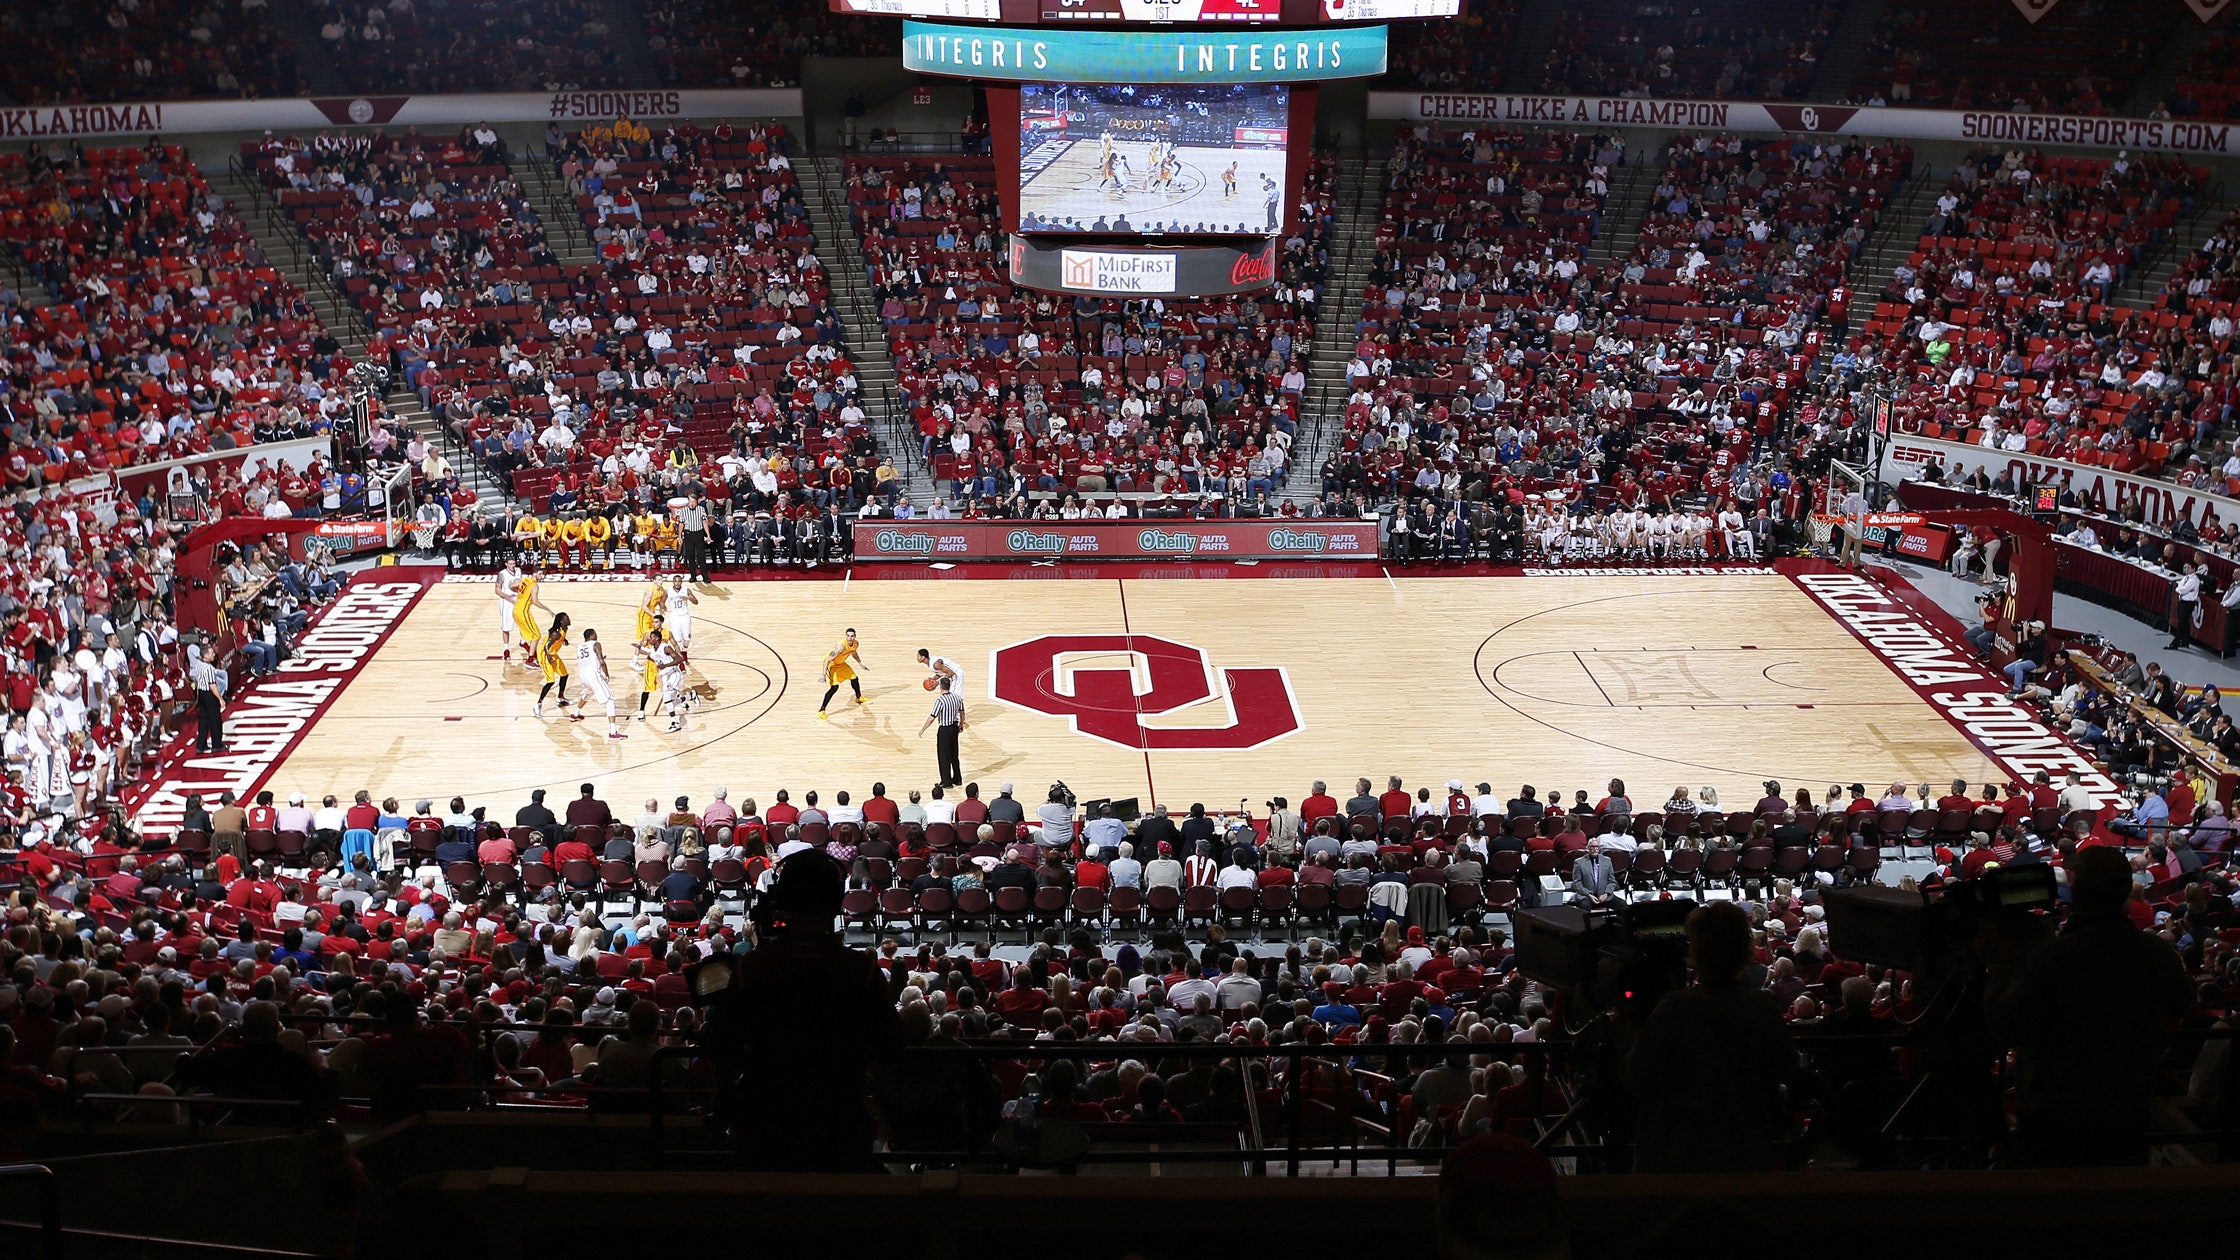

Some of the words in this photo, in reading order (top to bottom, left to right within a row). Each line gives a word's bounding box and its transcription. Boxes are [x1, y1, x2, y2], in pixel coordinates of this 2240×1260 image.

[1155, 6, 1170, 19] 1ST
[917, 33, 1048, 70] INTEGRIS
[1178, 40, 1342, 72] INTEGRIS
[550, 91, 680, 117] #SOONERS
[913, 95, 931, 104] LE3
[1419, 95, 1498, 119] CHEER
[1505, 97, 1568, 121] LIKE
[1572, 98, 1590, 122] A
[1597, 100, 1729, 127] CHAMPION
[1962, 113, 2229, 152] SOONERSPORTS.COM
[1831, 292, 1842, 302] 34
[1892, 445, 1946, 467] ESPN
[357, 535, 382, 546] PARTS
[876, 530, 936, 553] O'Reilly
[939, 536, 965, 544] AUTO
[1007, 530, 1067, 553] O'Reilly
[1070, 535, 1096, 544] AUTO
[1138, 529, 1198, 552] O'Reilly
[1201, 535, 1227, 543] AUTO
[1268, 528, 1327, 552] O'Reilly
[1330, 534, 1356, 542] AUTO
[1906, 535, 1927, 545] AUTO
[937, 543, 968, 552] PARTS
[1069, 543, 1099, 551] PARTS
[1199, 543, 1229, 551] PARTS
[1329, 541, 1359, 550] PARTS
[1902, 541, 1928, 553] PARTS
[1522, 567, 1779, 577] SOONERSPORTS.COM
[674, 600, 683, 608] 10
[277, 582, 423, 673] SOONERS
[1796, 573, 1985, 687] OKLAHOMA
[579, 647, 590, 659] 35
[1456, 798, 1466, 810] 3
[256, 808, 266, 822] 3
